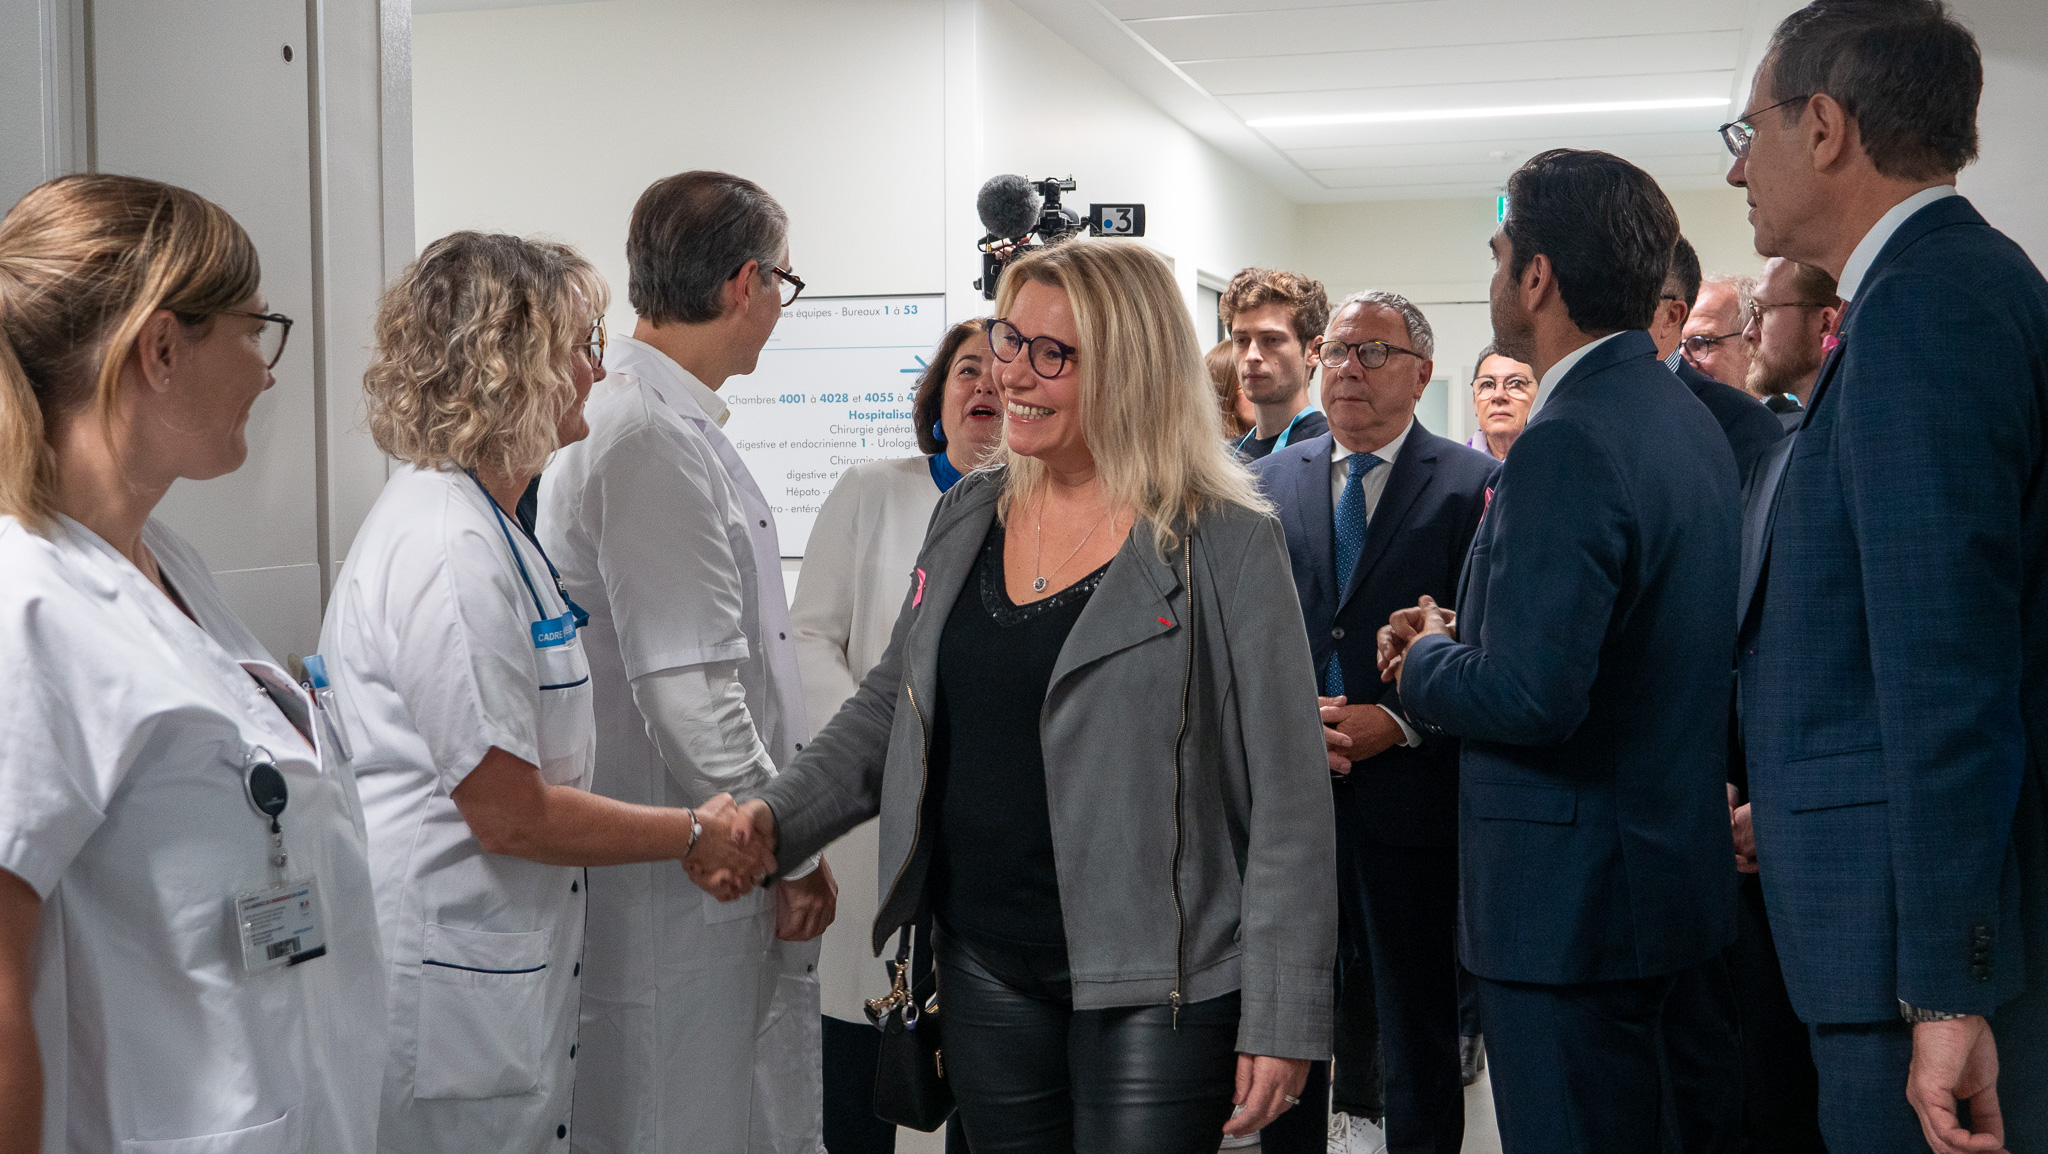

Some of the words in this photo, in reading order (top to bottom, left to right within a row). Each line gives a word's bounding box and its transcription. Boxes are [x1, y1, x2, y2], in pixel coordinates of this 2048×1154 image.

[1114, 208, 1132, 232] 3
[796, 308, 832, 320] équipes
[841, 306, 881, 317] Bureaux
[884, 305, 889, 316] 1
[893, 306, 900, 316] à
[903, 304, 918, 316] 53
[727, 394, 776, 405] Chambres
[778, 393, 806, 404] 4001
[810, 394, 817, 404] à
[819, 393, 849, 404] 4028
[852, 394, 862, 404] et
[864, 392, 895, 403] 4055
[897, 393, 904, 403] à
[829, 424, 874, 436] Chirurgie
[735, 439, 777, 452] digestive
[778, 440, 788, 449] et
[790, 438, 857, 449] endocrinienne
[861, 438, 866, 448] 1
[877, 437, 919, 450] Urologie
[785, 469, 827, 482] digestive
[829, 470, 839, 479] et
[786, 486, 821, 498] Hépato
[537, 630, 563, 642] CADRE
